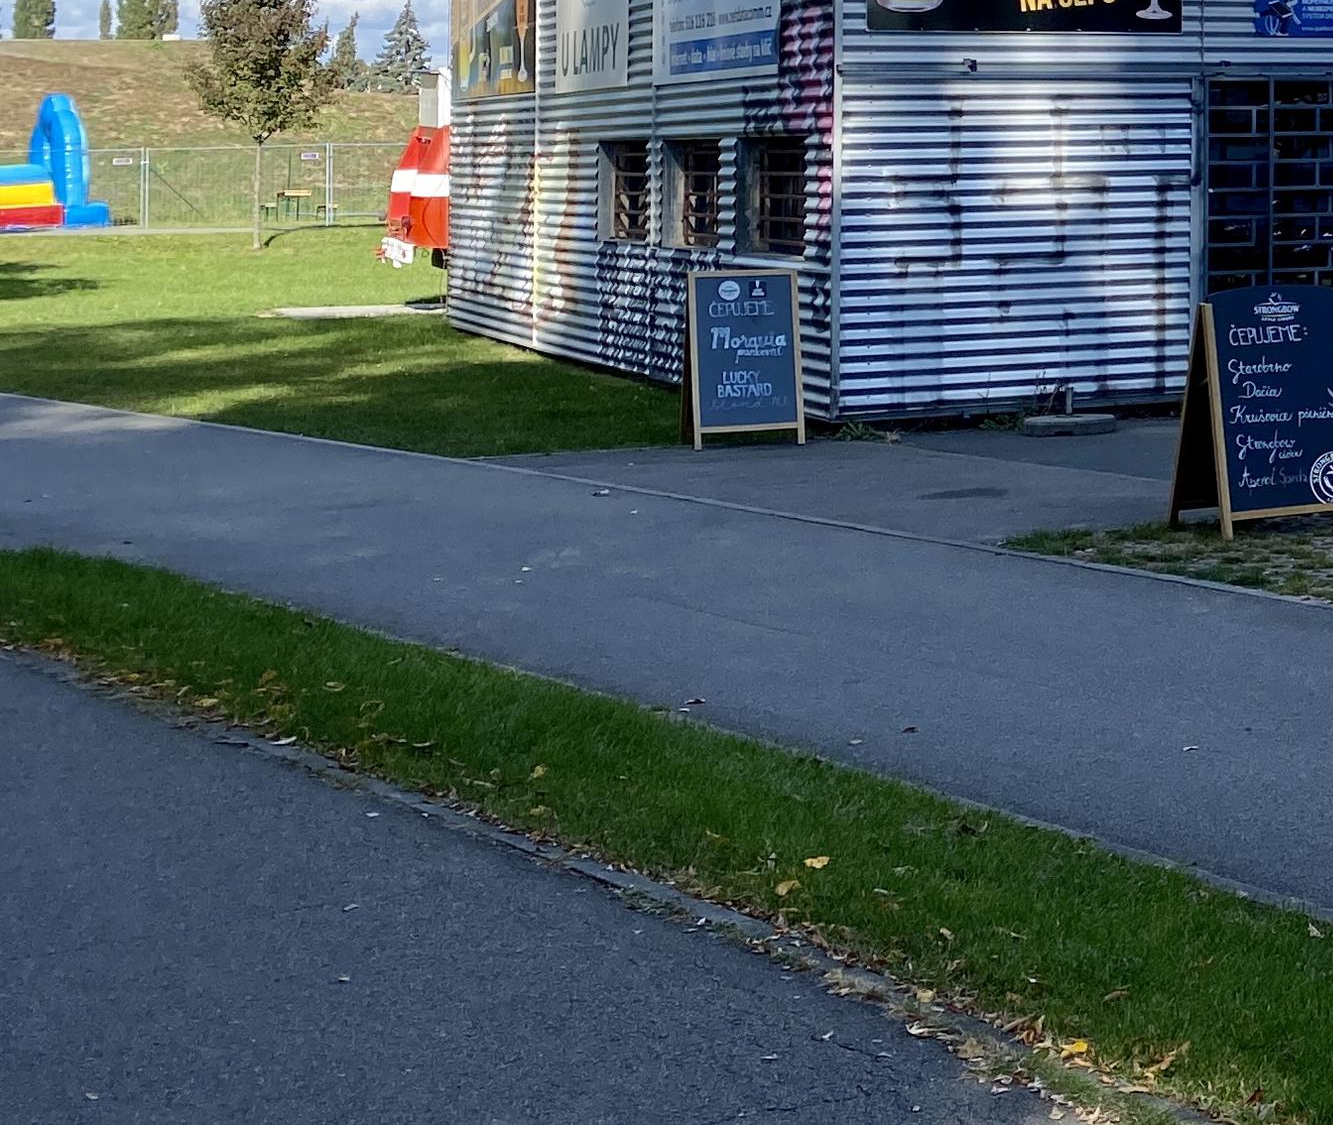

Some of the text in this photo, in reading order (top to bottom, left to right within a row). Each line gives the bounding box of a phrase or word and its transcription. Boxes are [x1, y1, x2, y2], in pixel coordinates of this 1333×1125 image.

[561, 32, 569, 77] U
[573, 22, 620, 75] LAMPY
[1253, 305, 1300, 315] STRONGBOW
[722, 371, 760, 384] LUCKY
[717, 382, 772, 398] BASTARD
